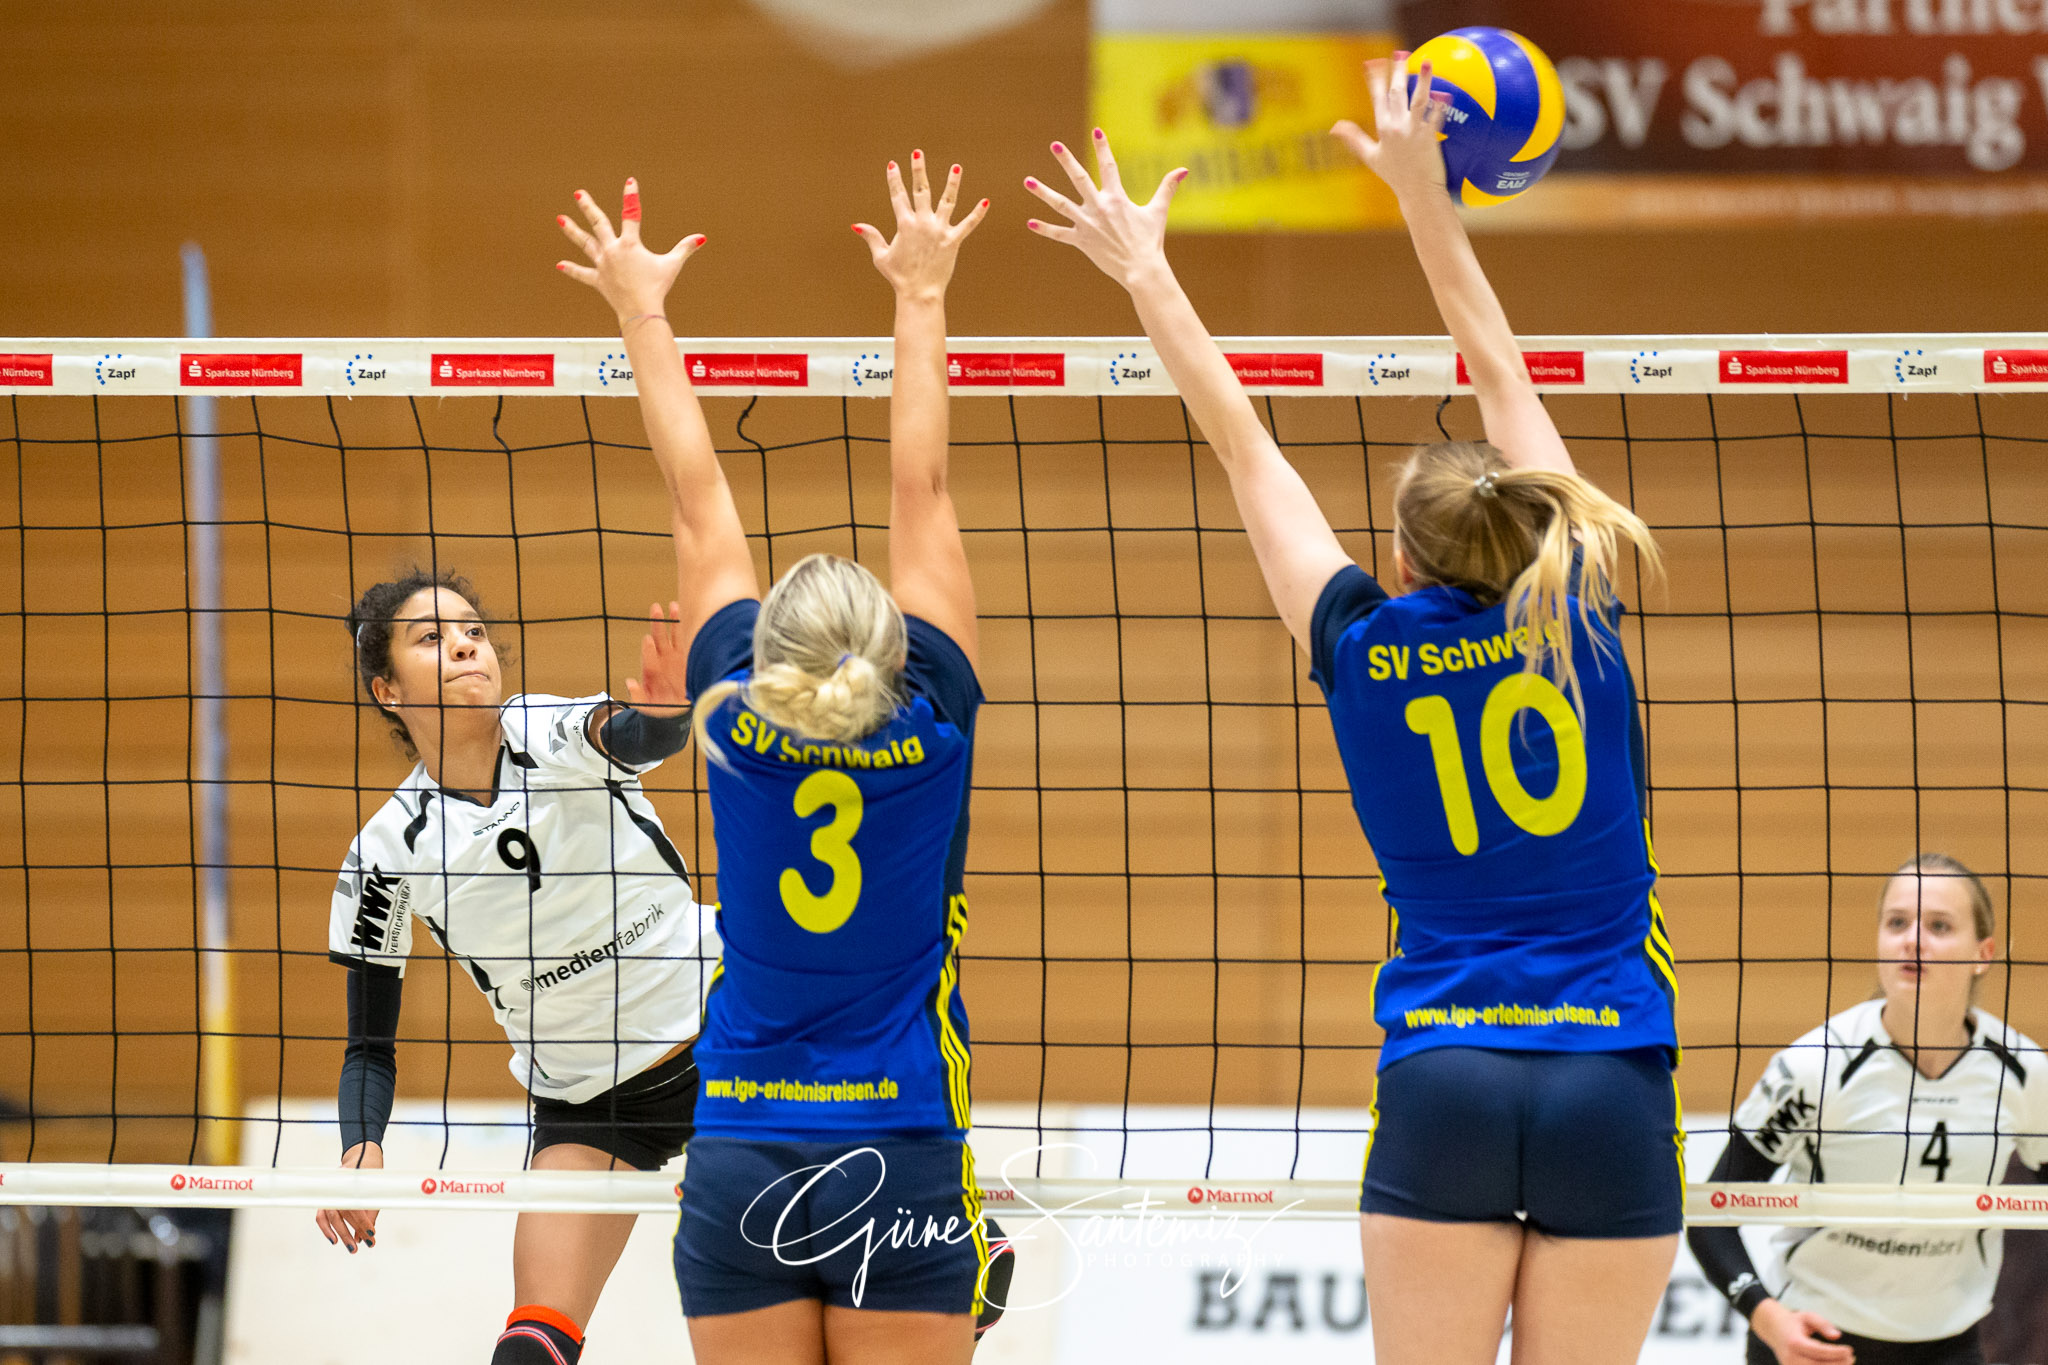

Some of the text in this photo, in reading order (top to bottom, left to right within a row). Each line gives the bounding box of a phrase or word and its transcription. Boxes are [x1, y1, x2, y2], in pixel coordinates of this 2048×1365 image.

[1559, 55, 1667, 150] SV
[1680, 50, 2026, 171] Schwaig
[2, 367, 44, 379] Nürnberg
[107, 368, 135, 380] Zapf
[205, 367, 294, 380] Sparkasse Nürnberg
[358, 369, 386, 381] Zapf
[456, 368, 546, 380] Sparkasse Nürnberg
[610, 369, 633, 381] Zap
[709, 368, 799, 380] Sparkasse Nürnberg
[965, 367, 1056, 380] Sparkasse Nürnberg
[1122, 368, 1151, 380] Zapf
[1235, 367, 1315, 380] arkasse Nürnberg
[1381, 368, 1410, 380] Zapf
[1531, 366, 1576, 378] Nürnberg
[1643, 366, 1672, 379] Zapf
[1745, 364, 1839, 377] Sparkasse Nürnberg
[1908, 365, 1938, 378] Zapf
[2010, 363, 2048, 376] Sparkas
[1368, 645, 1410, 680] SV
[731, 711, 776, 755] SV
[1404, 671, 1588, 856] 10
[779, 769, 864, 934] 3
[497, 827, 542, 894] 9
[350, 862, 403, 952] WWK
[1404, 1001, 1621, 1028] www.ige-erlebnisreisen.de
[706, 1076, 899, 1102] www.ige-erlebnisreisen.de
[1755, 1088, 1816, 1153] WWK
[1920, 1121, 1952, 1183] 4
[188, 1176, 254, 1191] Marmot
[440, 1180, 505, 1194] Marmot
[985, 1188, 1016, 1201] mot
[1207, 1189, 1275, 1204] Marmot
[1730, 1193, 1799, 1209] Marmot
[1996, 1197, 2048, 1211] Marm
